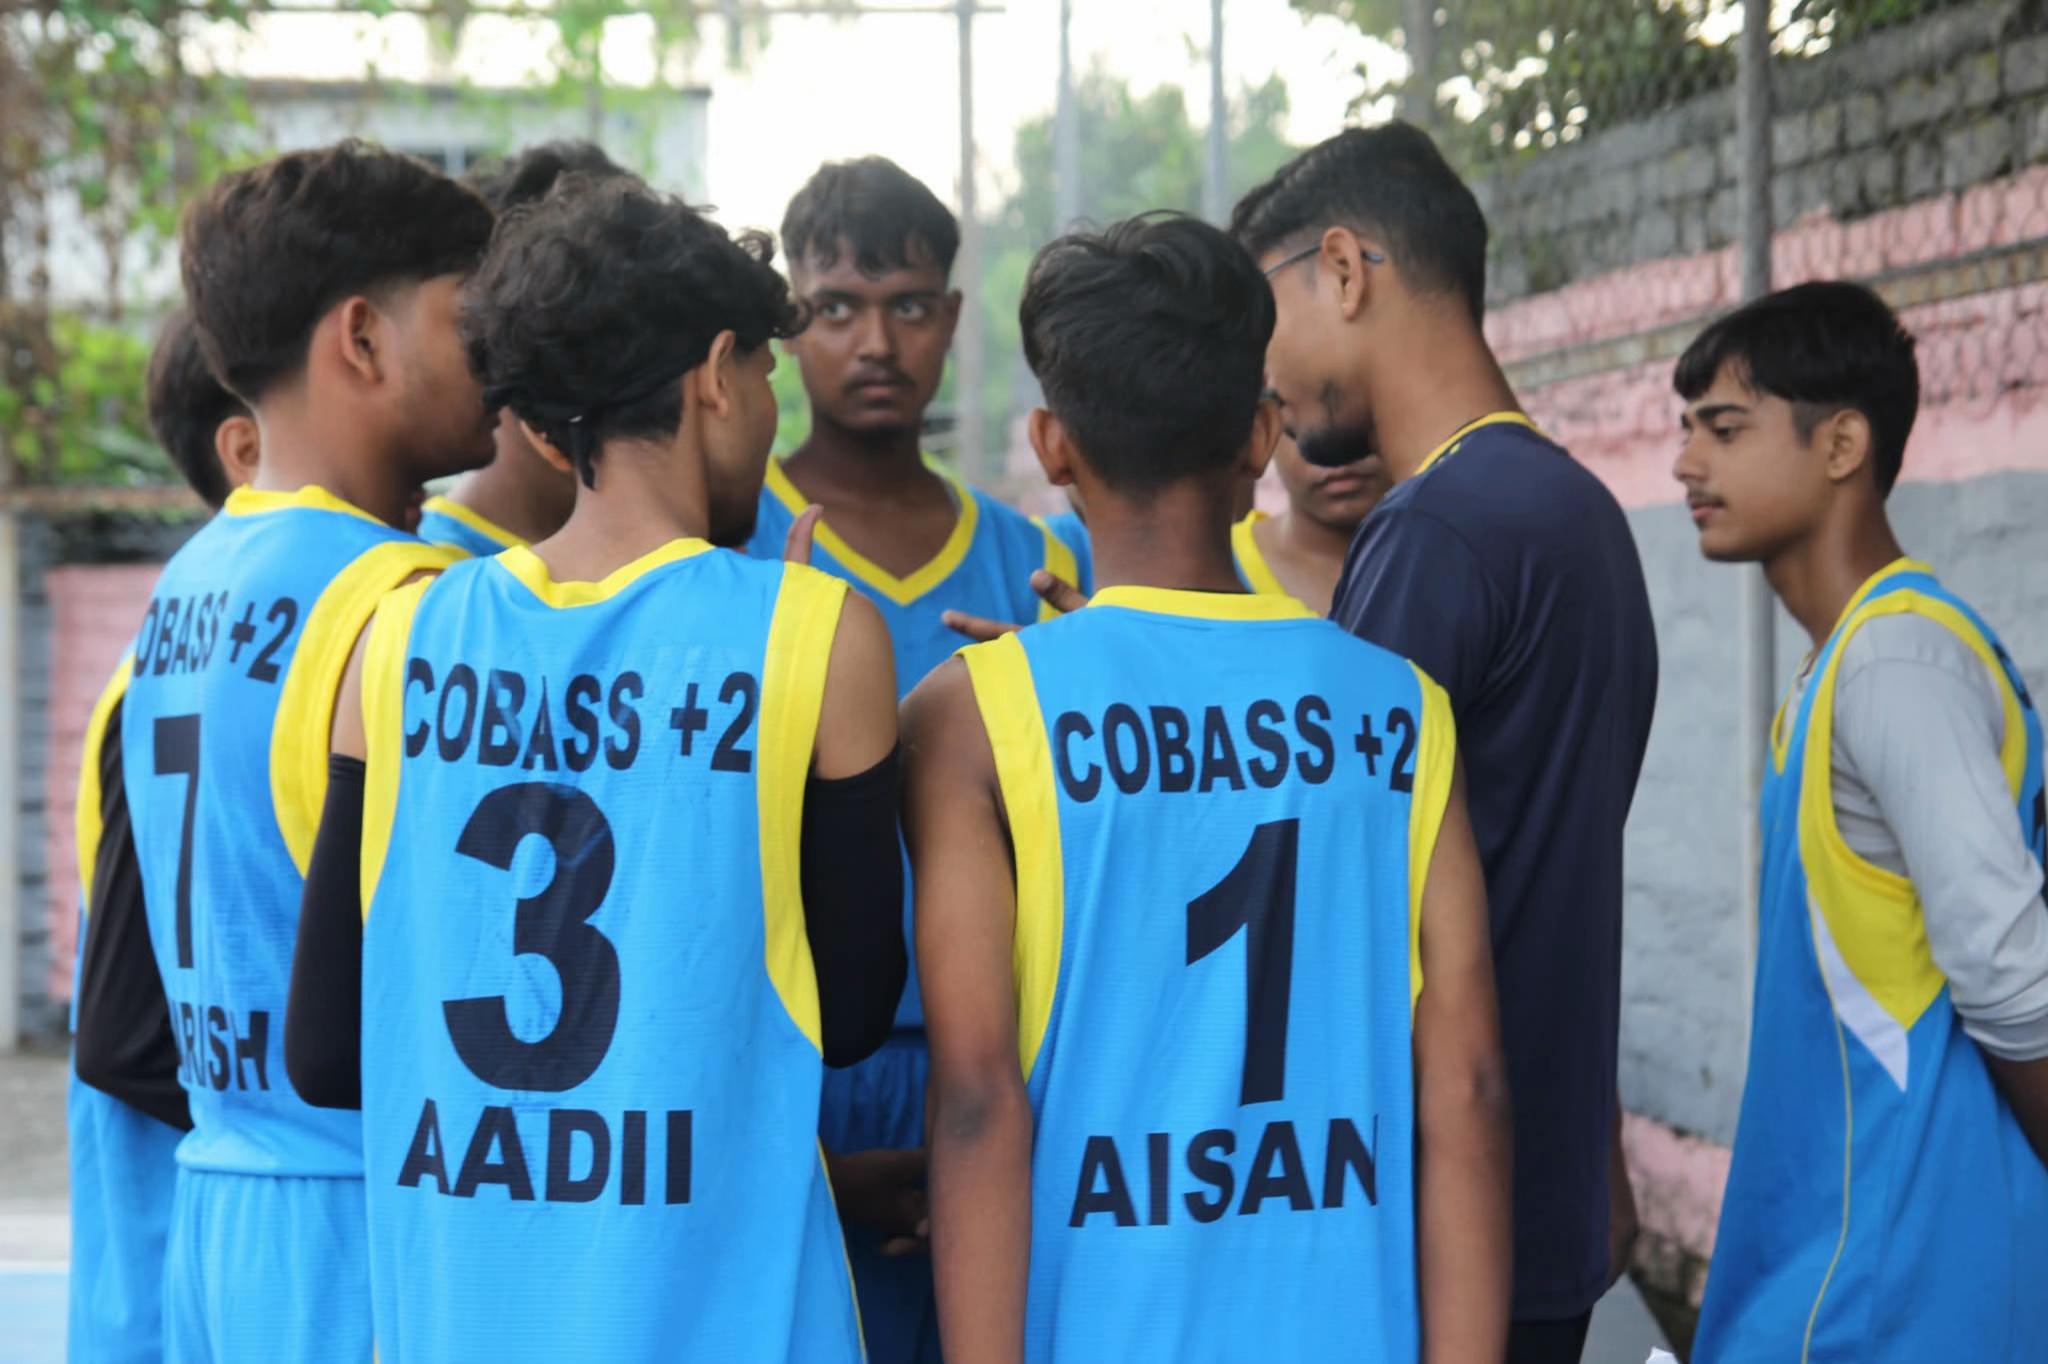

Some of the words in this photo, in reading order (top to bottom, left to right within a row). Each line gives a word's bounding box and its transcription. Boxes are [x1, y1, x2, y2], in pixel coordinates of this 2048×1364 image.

[229, 596, 298, 684] +2
[405, 657, 645, 773] COBASS
[670, 671, 759, 773] +2
[1053, 695, 1335, 803] COBASS
[1355, 706, 1416, 794] +2
[153, 713, 201, 969] 7
[442, 781, 621, 1093] 3
[1186, 817, 1300, 1108] 1
[168, 1001, 270, 1092] RISH
[396, 1097, 693, 1206] AADII
[1068, 1114, 1378, 1228] AISAN
